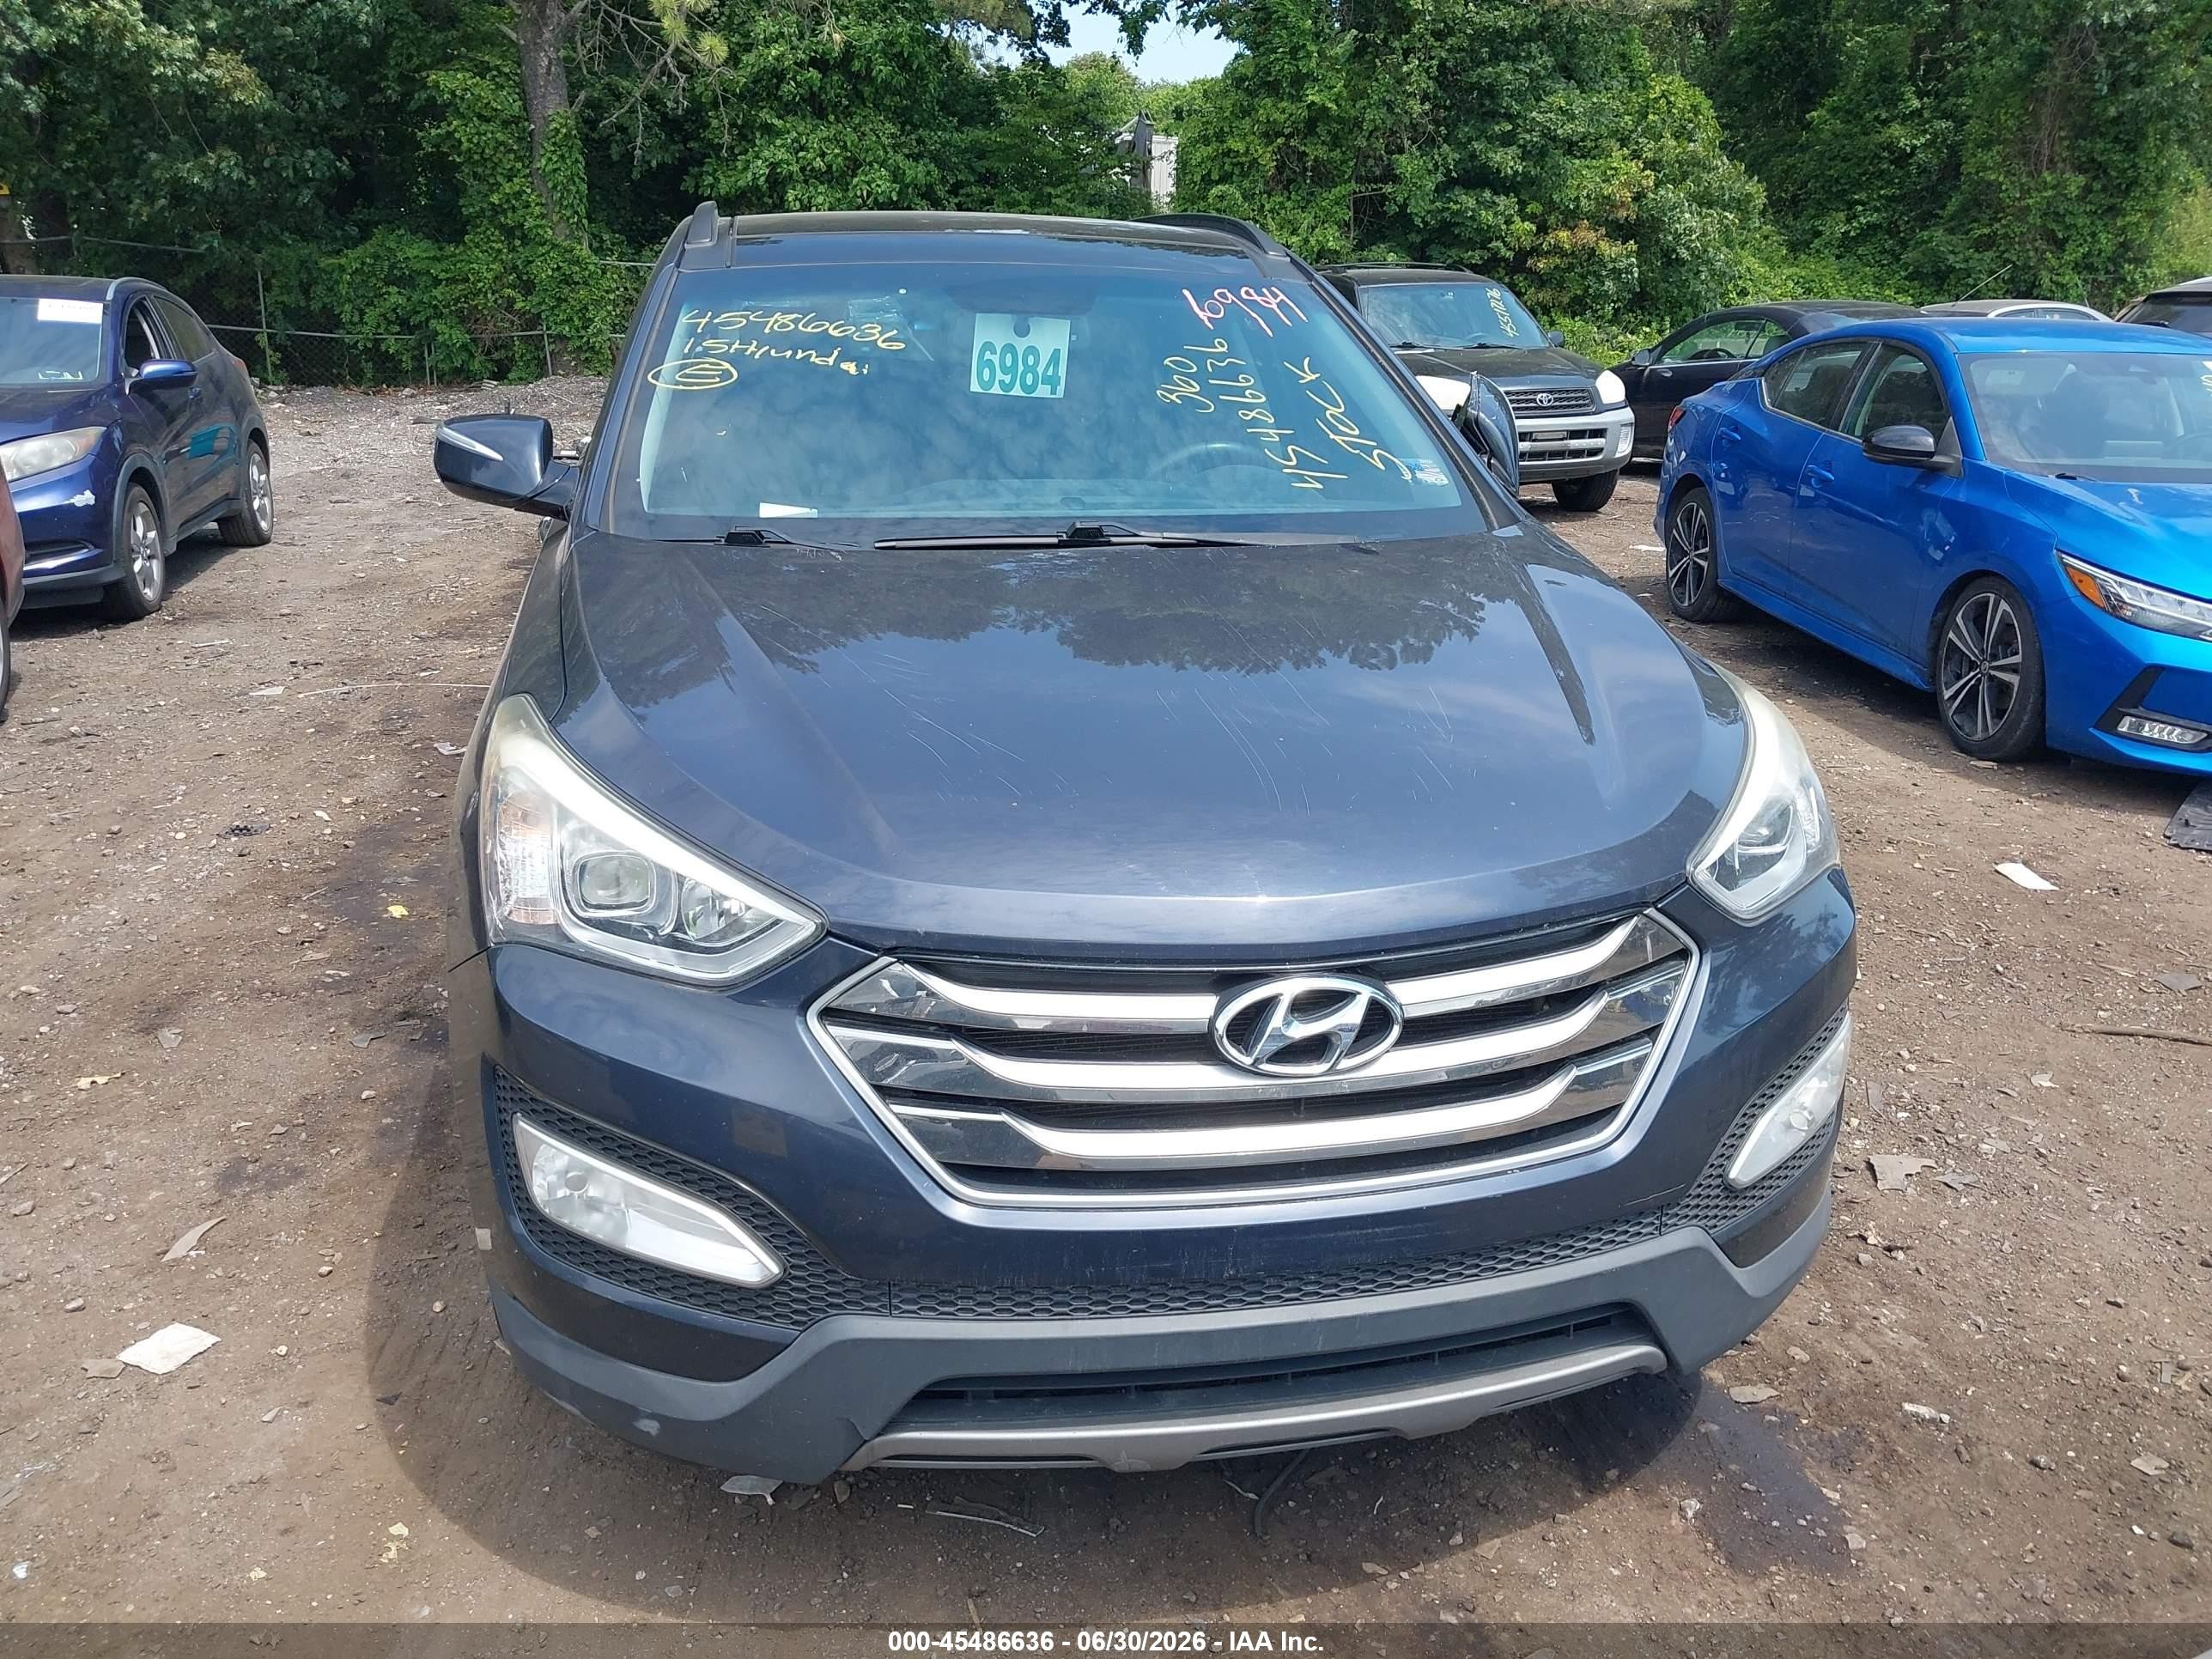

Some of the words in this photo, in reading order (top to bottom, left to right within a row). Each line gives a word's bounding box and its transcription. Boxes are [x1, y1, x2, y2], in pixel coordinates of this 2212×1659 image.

[682, 309, 906, 349] 45486636
[1182, 286, 1309, 337] 6984
[976, 341, 1061, 395] 6984
[1183, 338, 1349, 489] 45486636
[1284, 356, 1413, 481] STOCK
